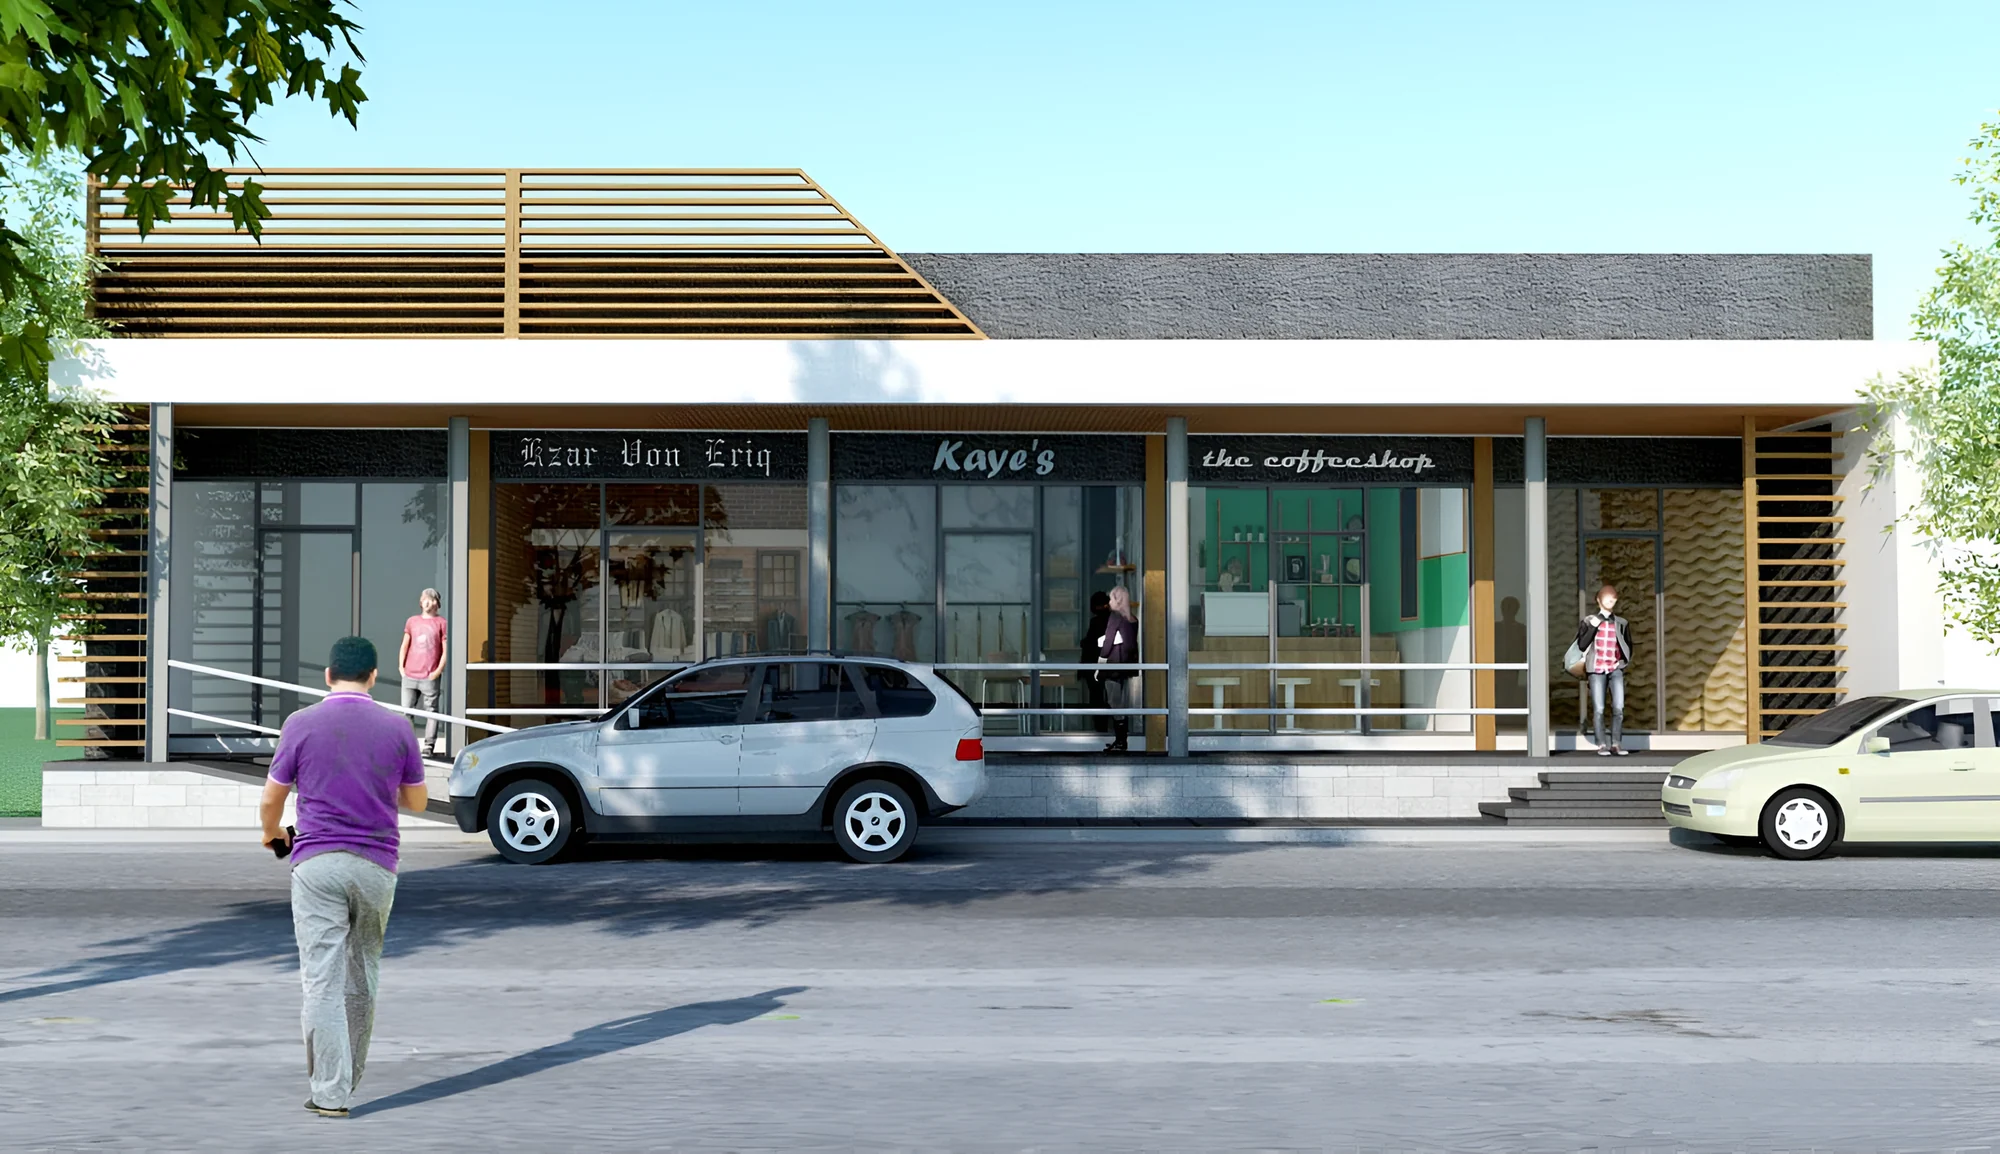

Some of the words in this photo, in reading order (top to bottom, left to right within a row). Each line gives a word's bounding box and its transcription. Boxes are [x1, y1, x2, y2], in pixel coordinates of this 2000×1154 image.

[520, 437, 598, 468] Kzar
[621, 438, 681, 468] Von
[705, 438, 772, 477] Eriq
[932, 438, 1055, 479] Kaye's
[1202, 448, 1253, 468] the
[1263, 449, 1436, 474] coffeeshop
